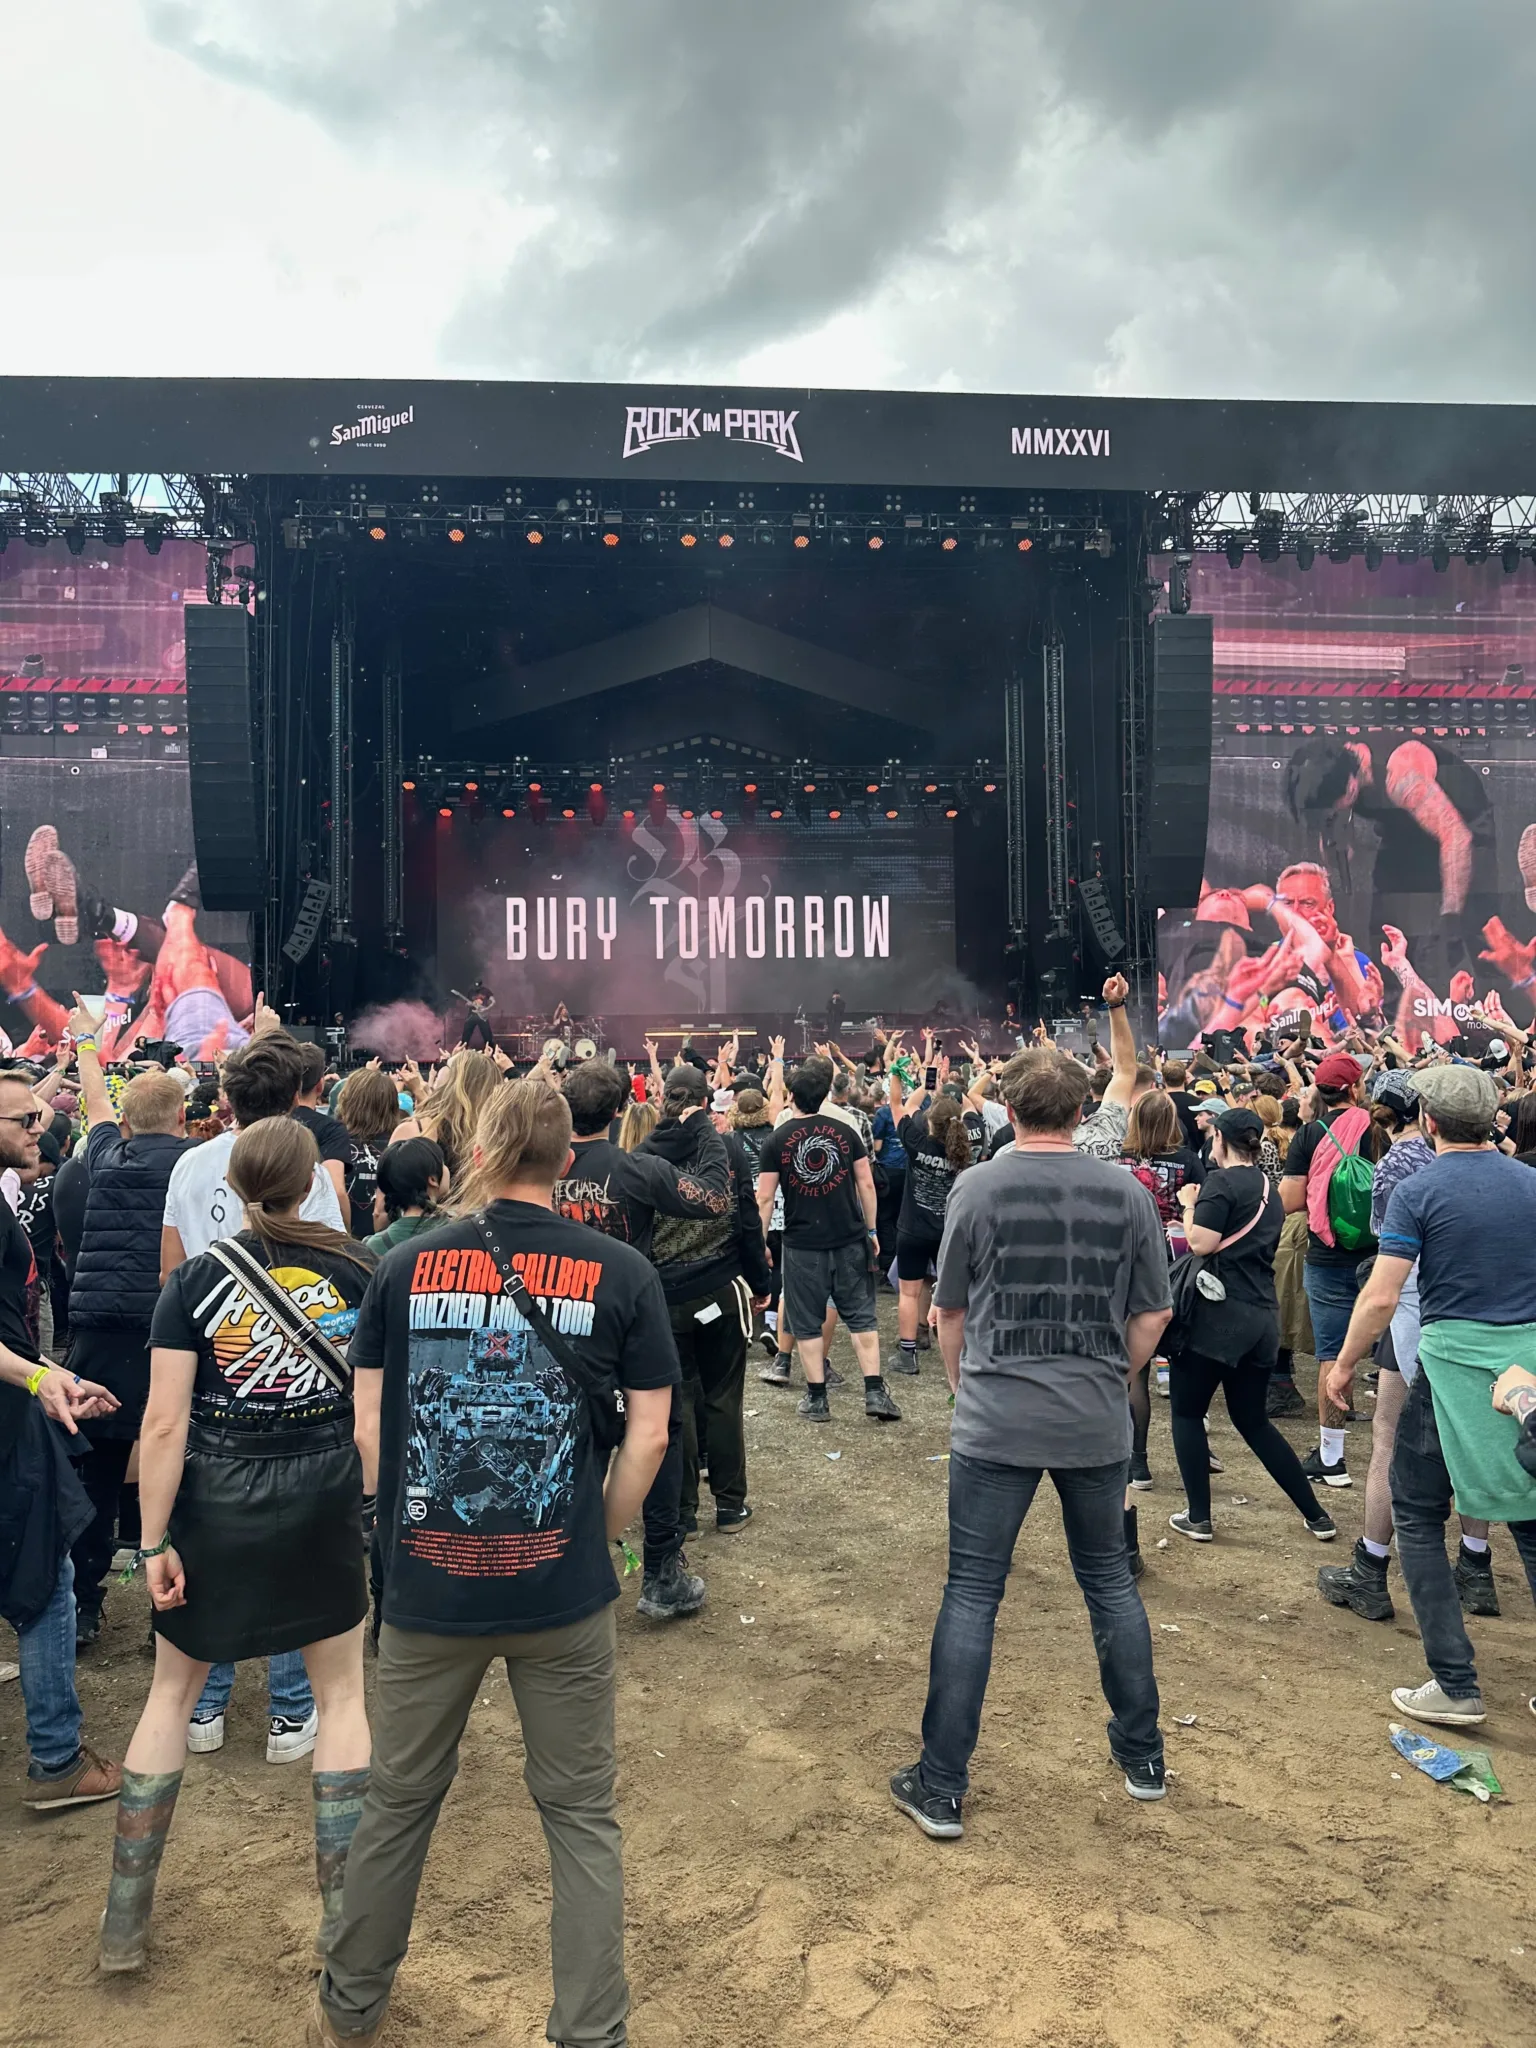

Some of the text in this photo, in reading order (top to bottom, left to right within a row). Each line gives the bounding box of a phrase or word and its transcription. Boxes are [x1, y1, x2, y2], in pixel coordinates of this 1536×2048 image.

[622, 406, 804, 463] ROCK IM PARK
[1011, 427, 1110, 457] MMXXVI
[506, 895, 890, 961] BURY TOMORROW
[781, 1125, 850, 1164] BE NOT AFRAID
[967, 1127, 982, 1141] RKS
[788, 1167, 849, 1197] OF THE DARK
[29, 1193, 49, 1211] IS
[409, 1292, 487, 1330] TANZNEID
[551, 1297, 596, 1337] TOUR
[992, 1328, 1066, 1356] LINKIN
[616, 1399, 625, 1412] B
